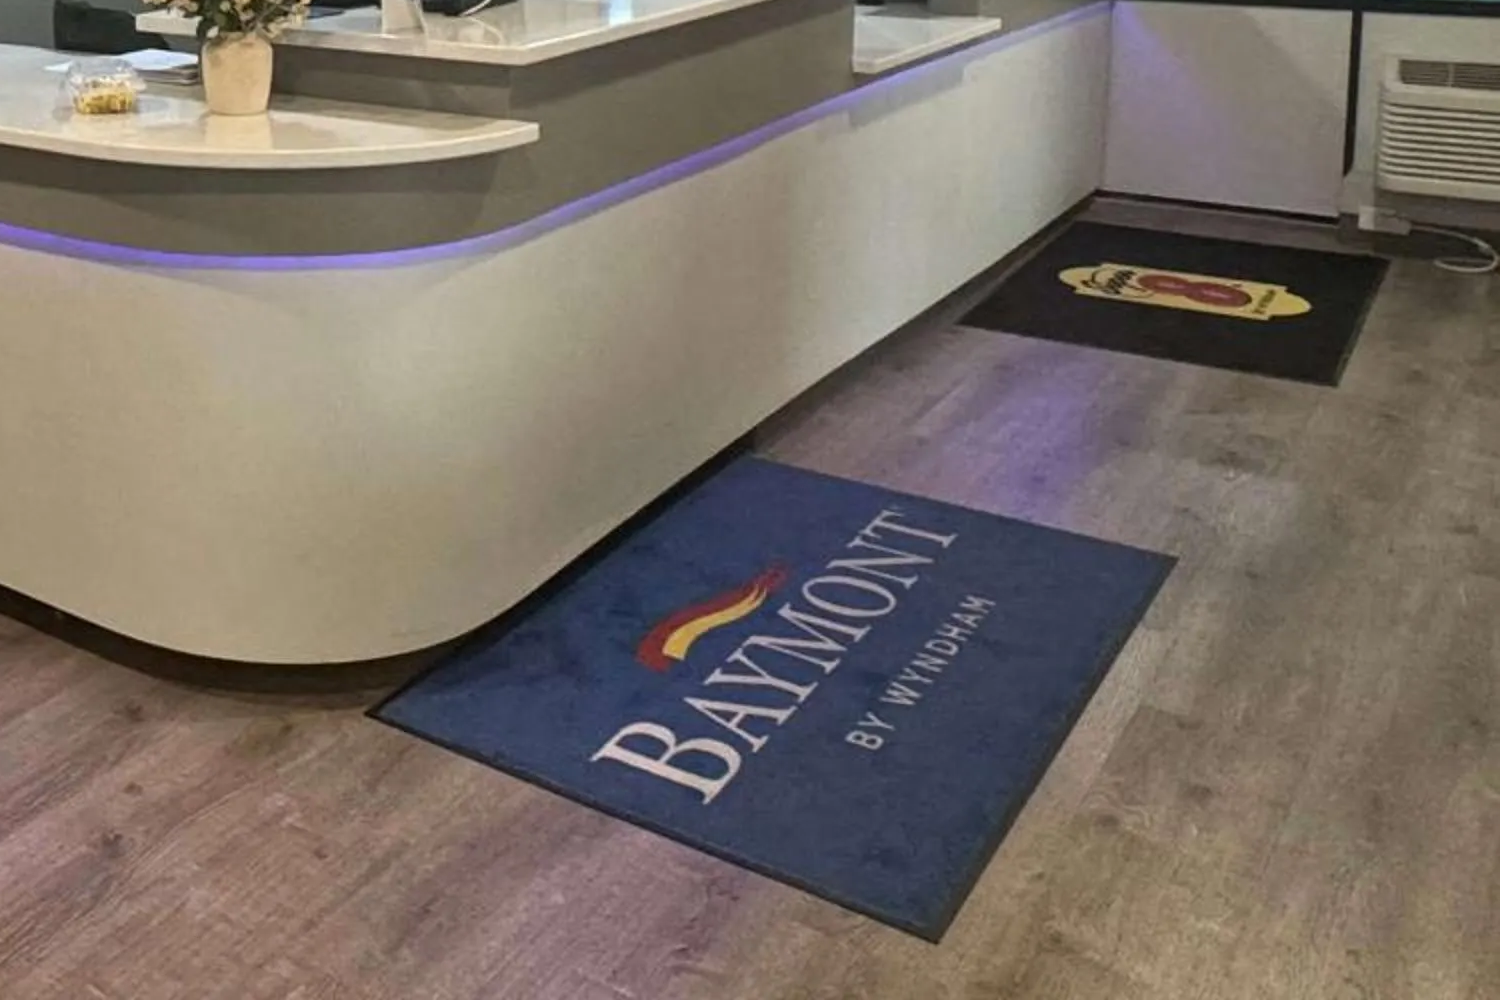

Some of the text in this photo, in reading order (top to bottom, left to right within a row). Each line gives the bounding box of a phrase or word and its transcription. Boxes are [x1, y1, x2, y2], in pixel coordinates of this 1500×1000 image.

[590, 507, 959, 805] BAYMONT
[845, 593, 998, 751] BY WYNDHAM
